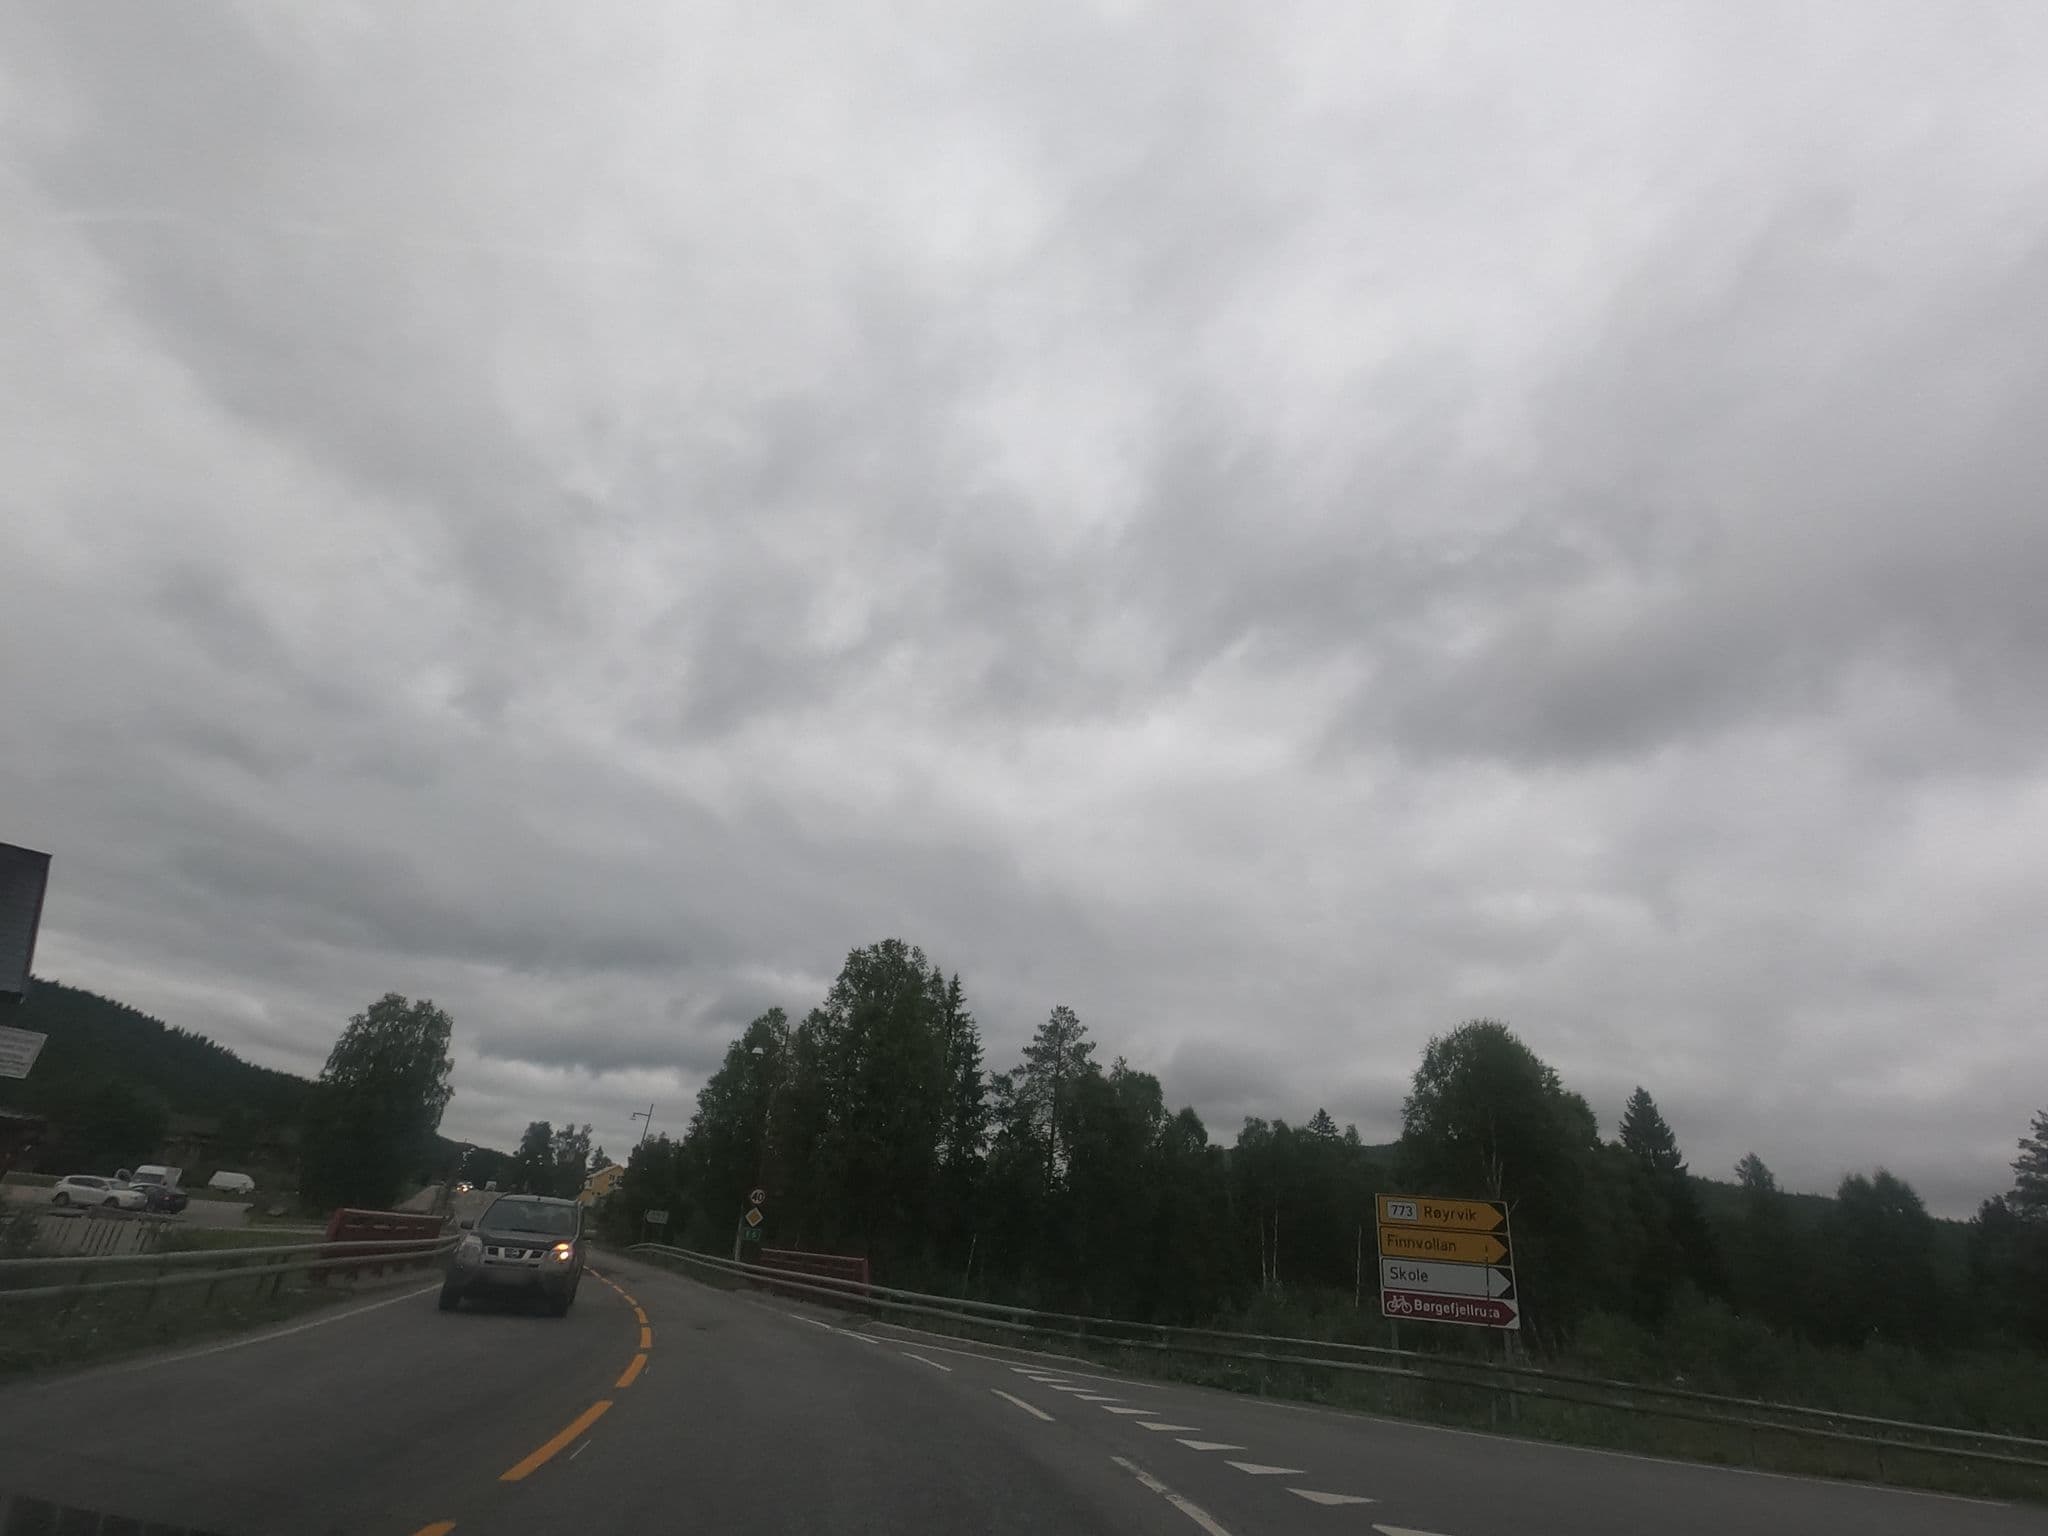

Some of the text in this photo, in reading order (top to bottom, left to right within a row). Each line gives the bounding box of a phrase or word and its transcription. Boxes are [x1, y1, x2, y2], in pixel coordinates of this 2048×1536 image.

[751, 1192, 764, 1202] 40
[1391, 1204, 1477, 1222] 773 Røyrvik
[1387, 1233, 1456, 1252] Finnvollan
[1390, 1266, 1429, 1281] Skole
